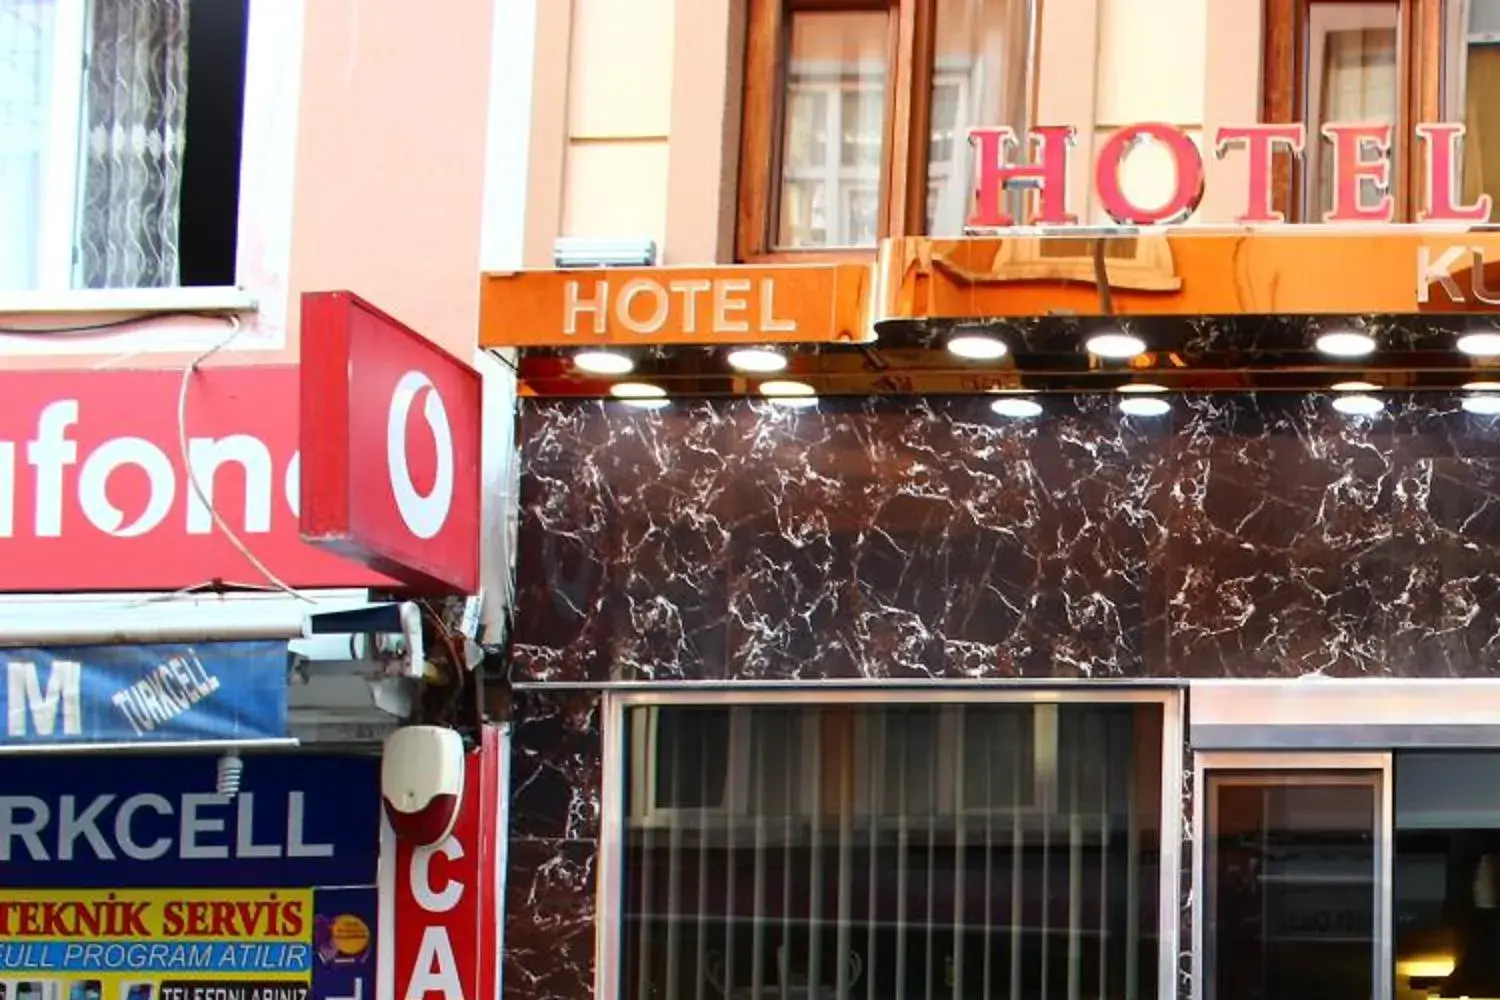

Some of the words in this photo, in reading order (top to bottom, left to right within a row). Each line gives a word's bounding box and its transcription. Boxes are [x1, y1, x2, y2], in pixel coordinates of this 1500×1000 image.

[968, 122, 1492, 226] HOTEL
[562, 278, 797, 335] HOTEL
[0, 400, 300, 537] fon
[7, 660, 82, 737] M
[111, 647, 221, 738] TURKCELL
[162, 892, 303, 937] SERVİS
[63, 943, 212, 968] PROGRAM
[218, 943, 308, 968] ATILIR
